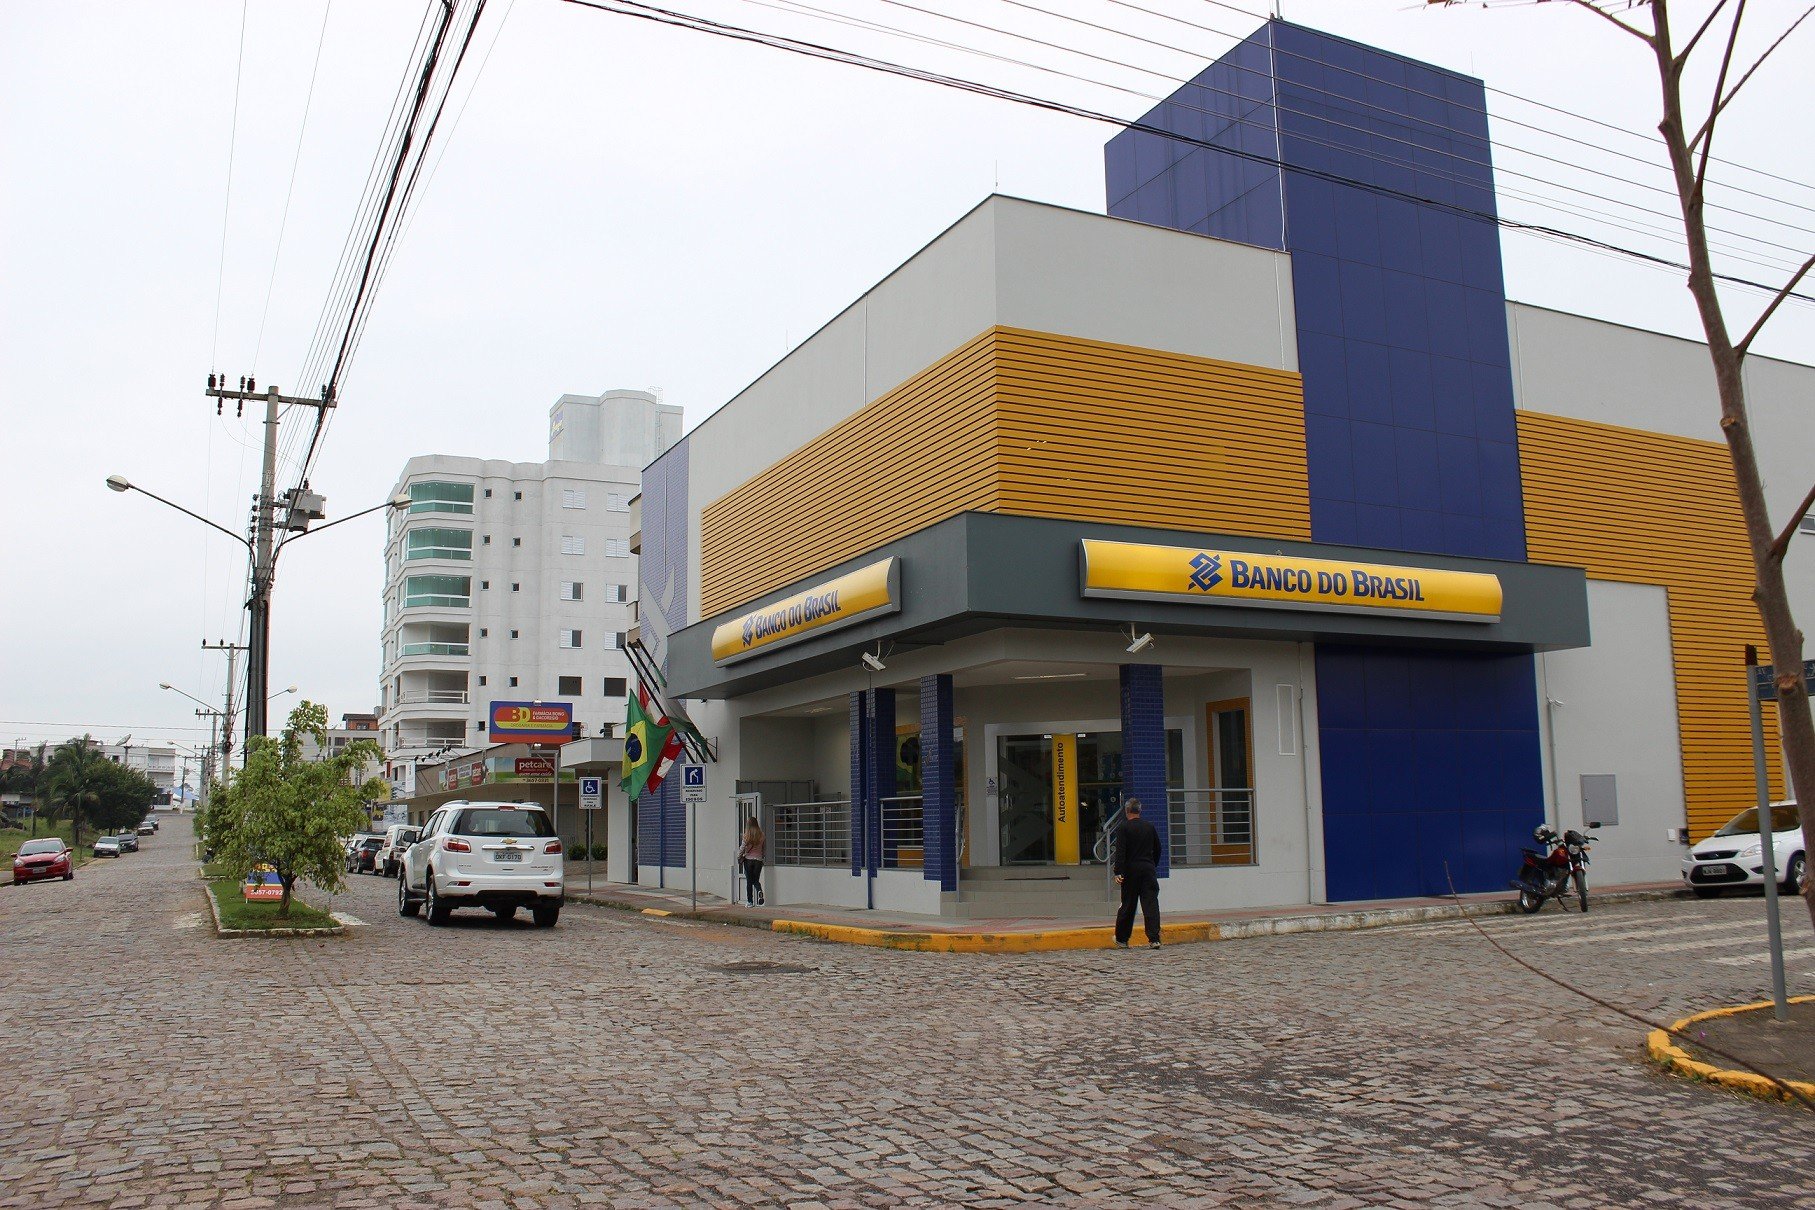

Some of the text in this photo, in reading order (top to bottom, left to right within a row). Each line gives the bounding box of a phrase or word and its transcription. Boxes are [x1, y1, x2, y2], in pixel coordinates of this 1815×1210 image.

[1230, 560, 1425, 602] BANCO DO BRASIL
[755, 590, 842, 640] BANCO DO BRASIL
[519, 761, 552, 770] petcare
[1058, 742, 1066, 823] Autoatendimento
